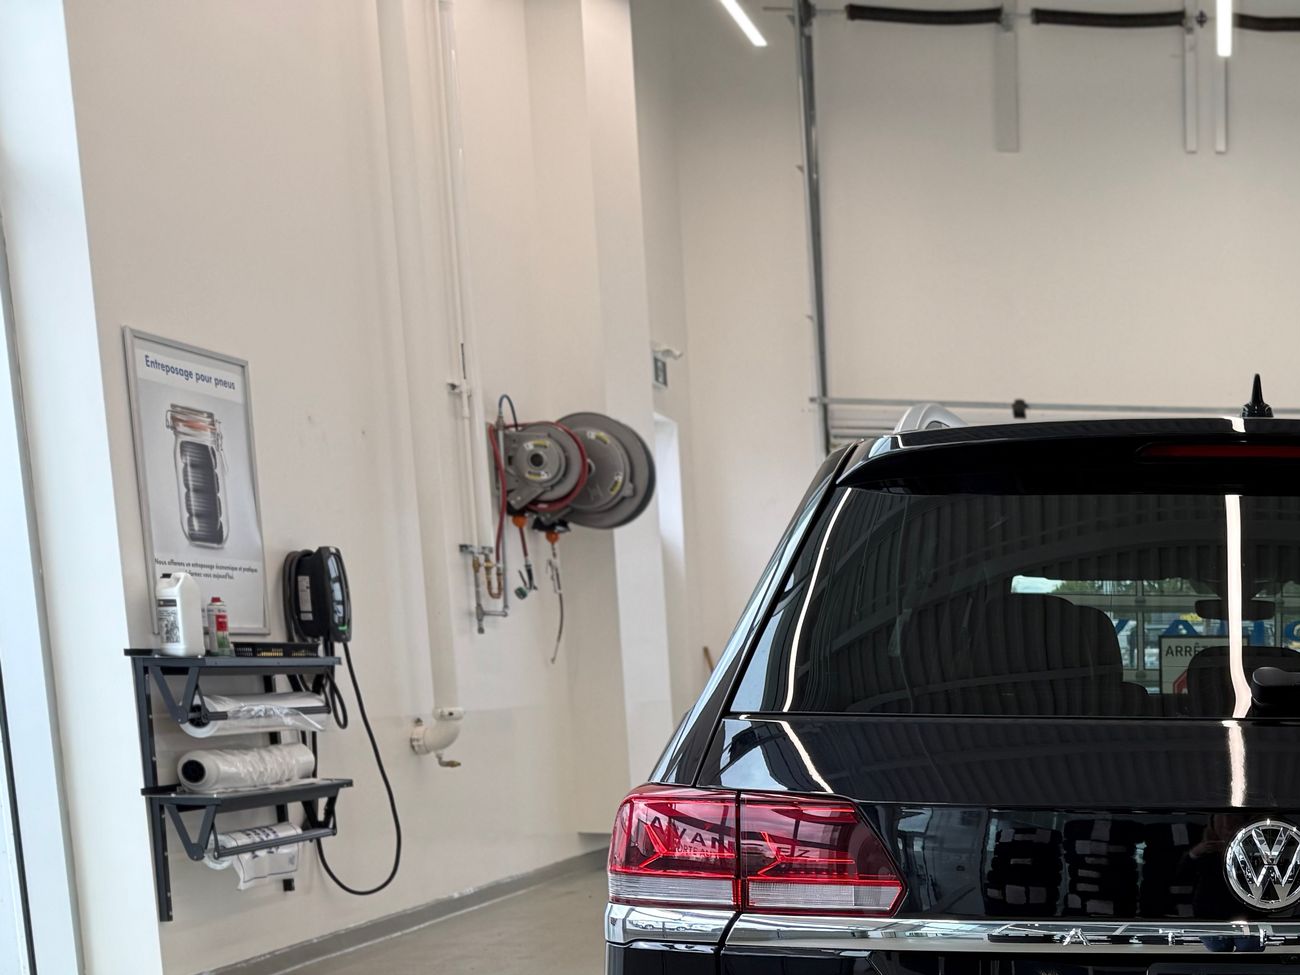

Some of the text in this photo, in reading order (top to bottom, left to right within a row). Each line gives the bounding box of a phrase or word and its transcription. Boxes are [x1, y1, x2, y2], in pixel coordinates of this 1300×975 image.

[144, 354, 236, 390] Entreposage pour pneus
